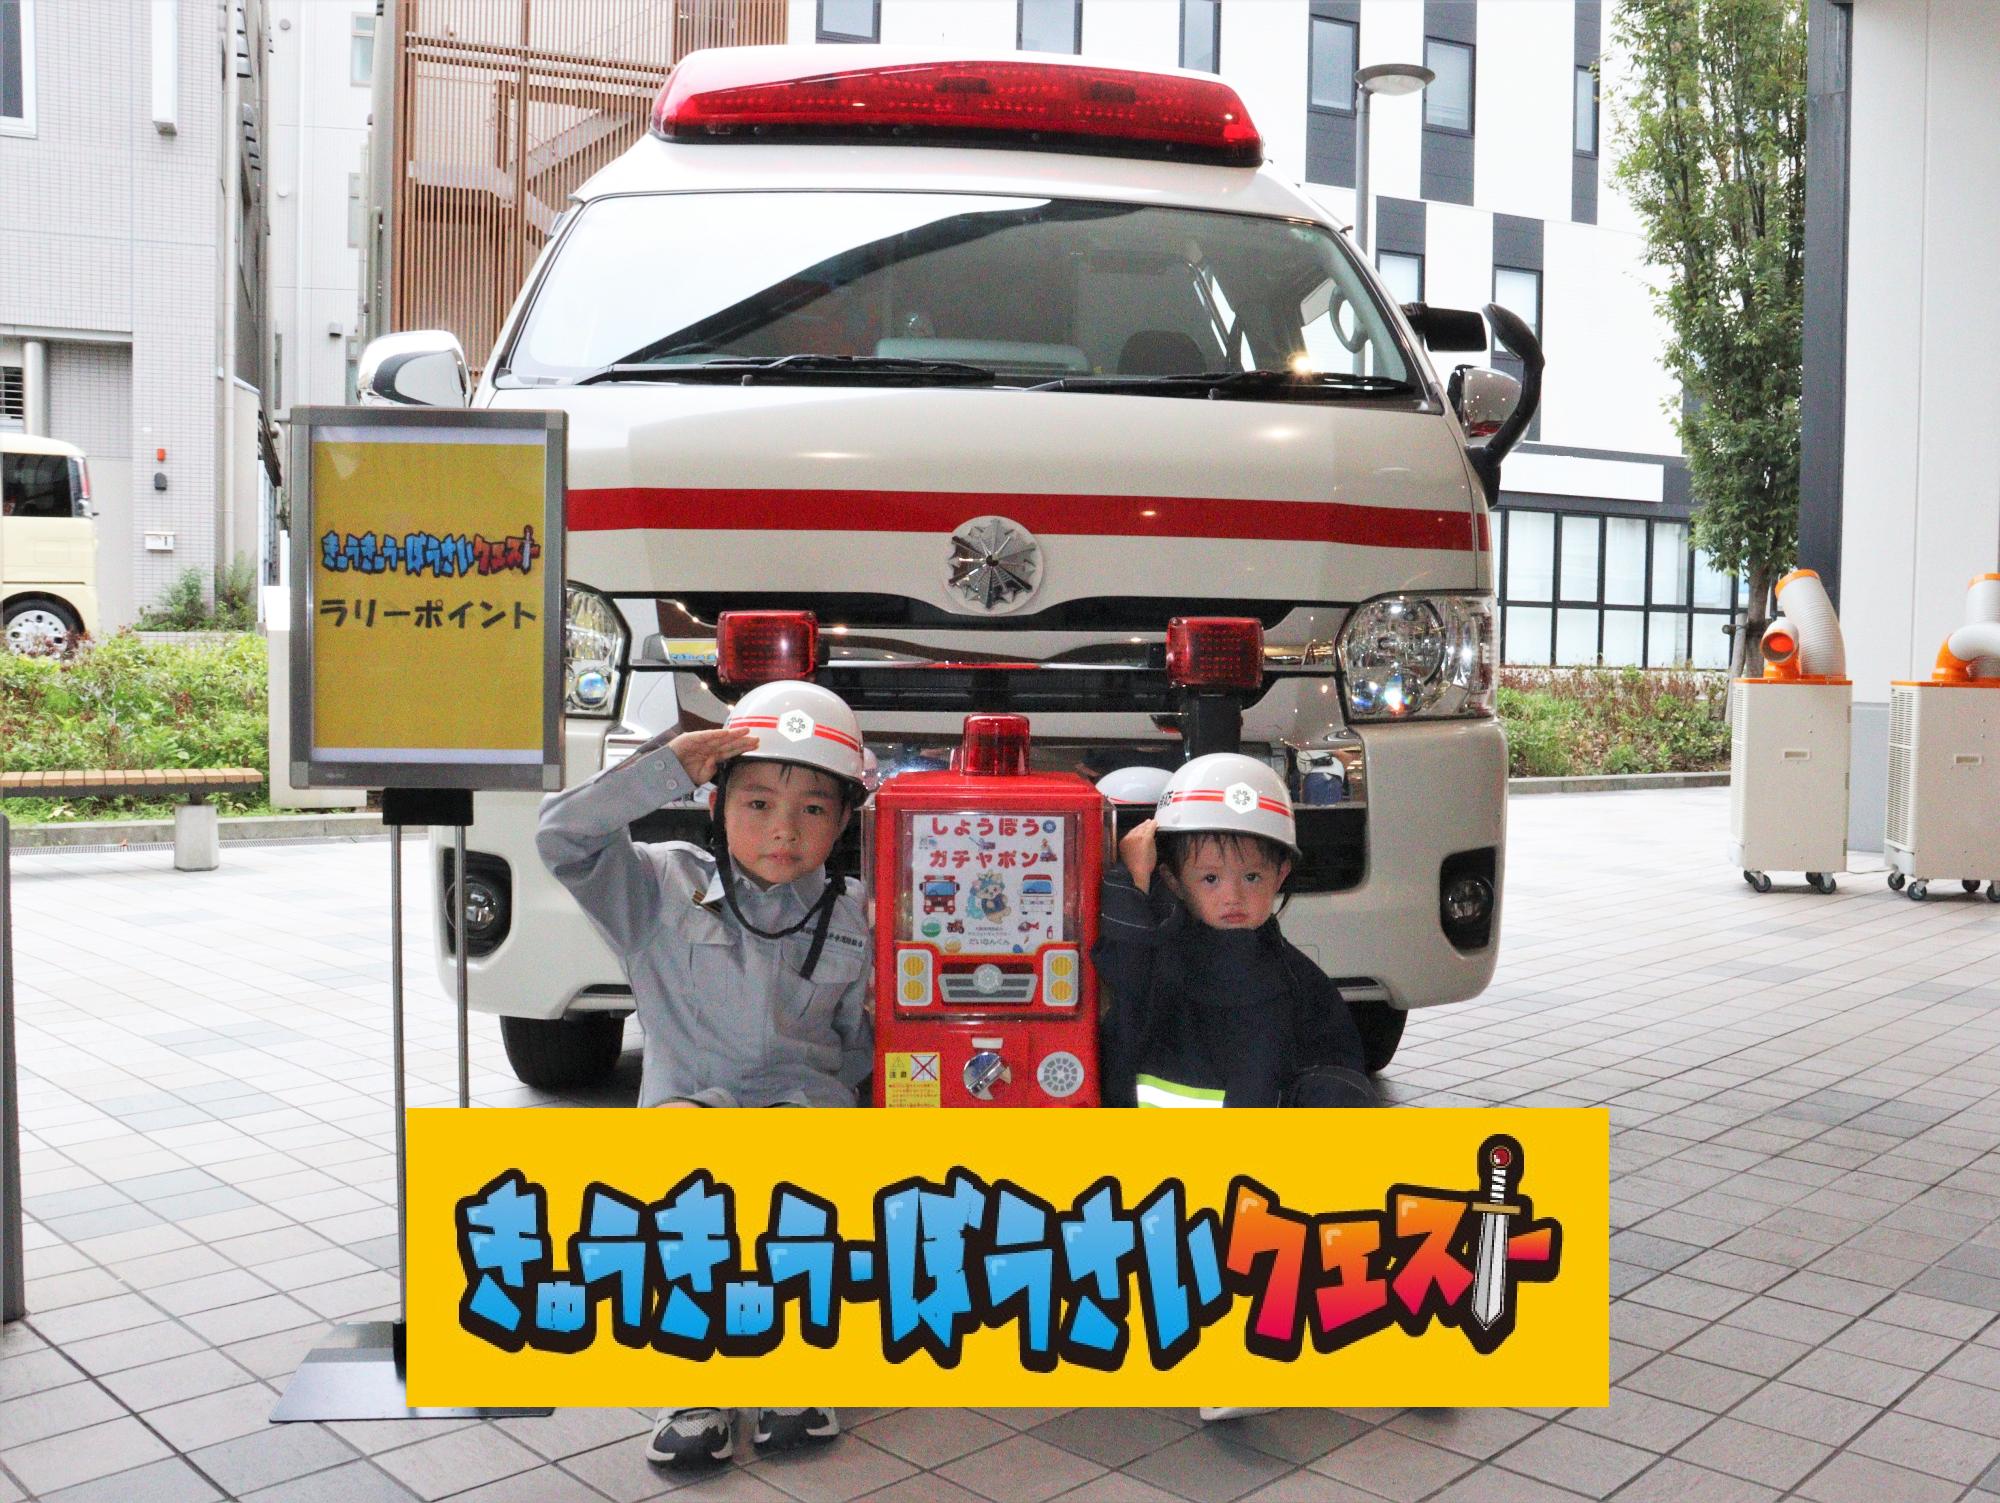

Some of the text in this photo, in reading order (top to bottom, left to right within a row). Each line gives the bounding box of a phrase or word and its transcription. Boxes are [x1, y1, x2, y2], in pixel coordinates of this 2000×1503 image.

[320, 599, 537, 630] ラリーポイント
[931, 816, 1040, 837] しょうぼう
